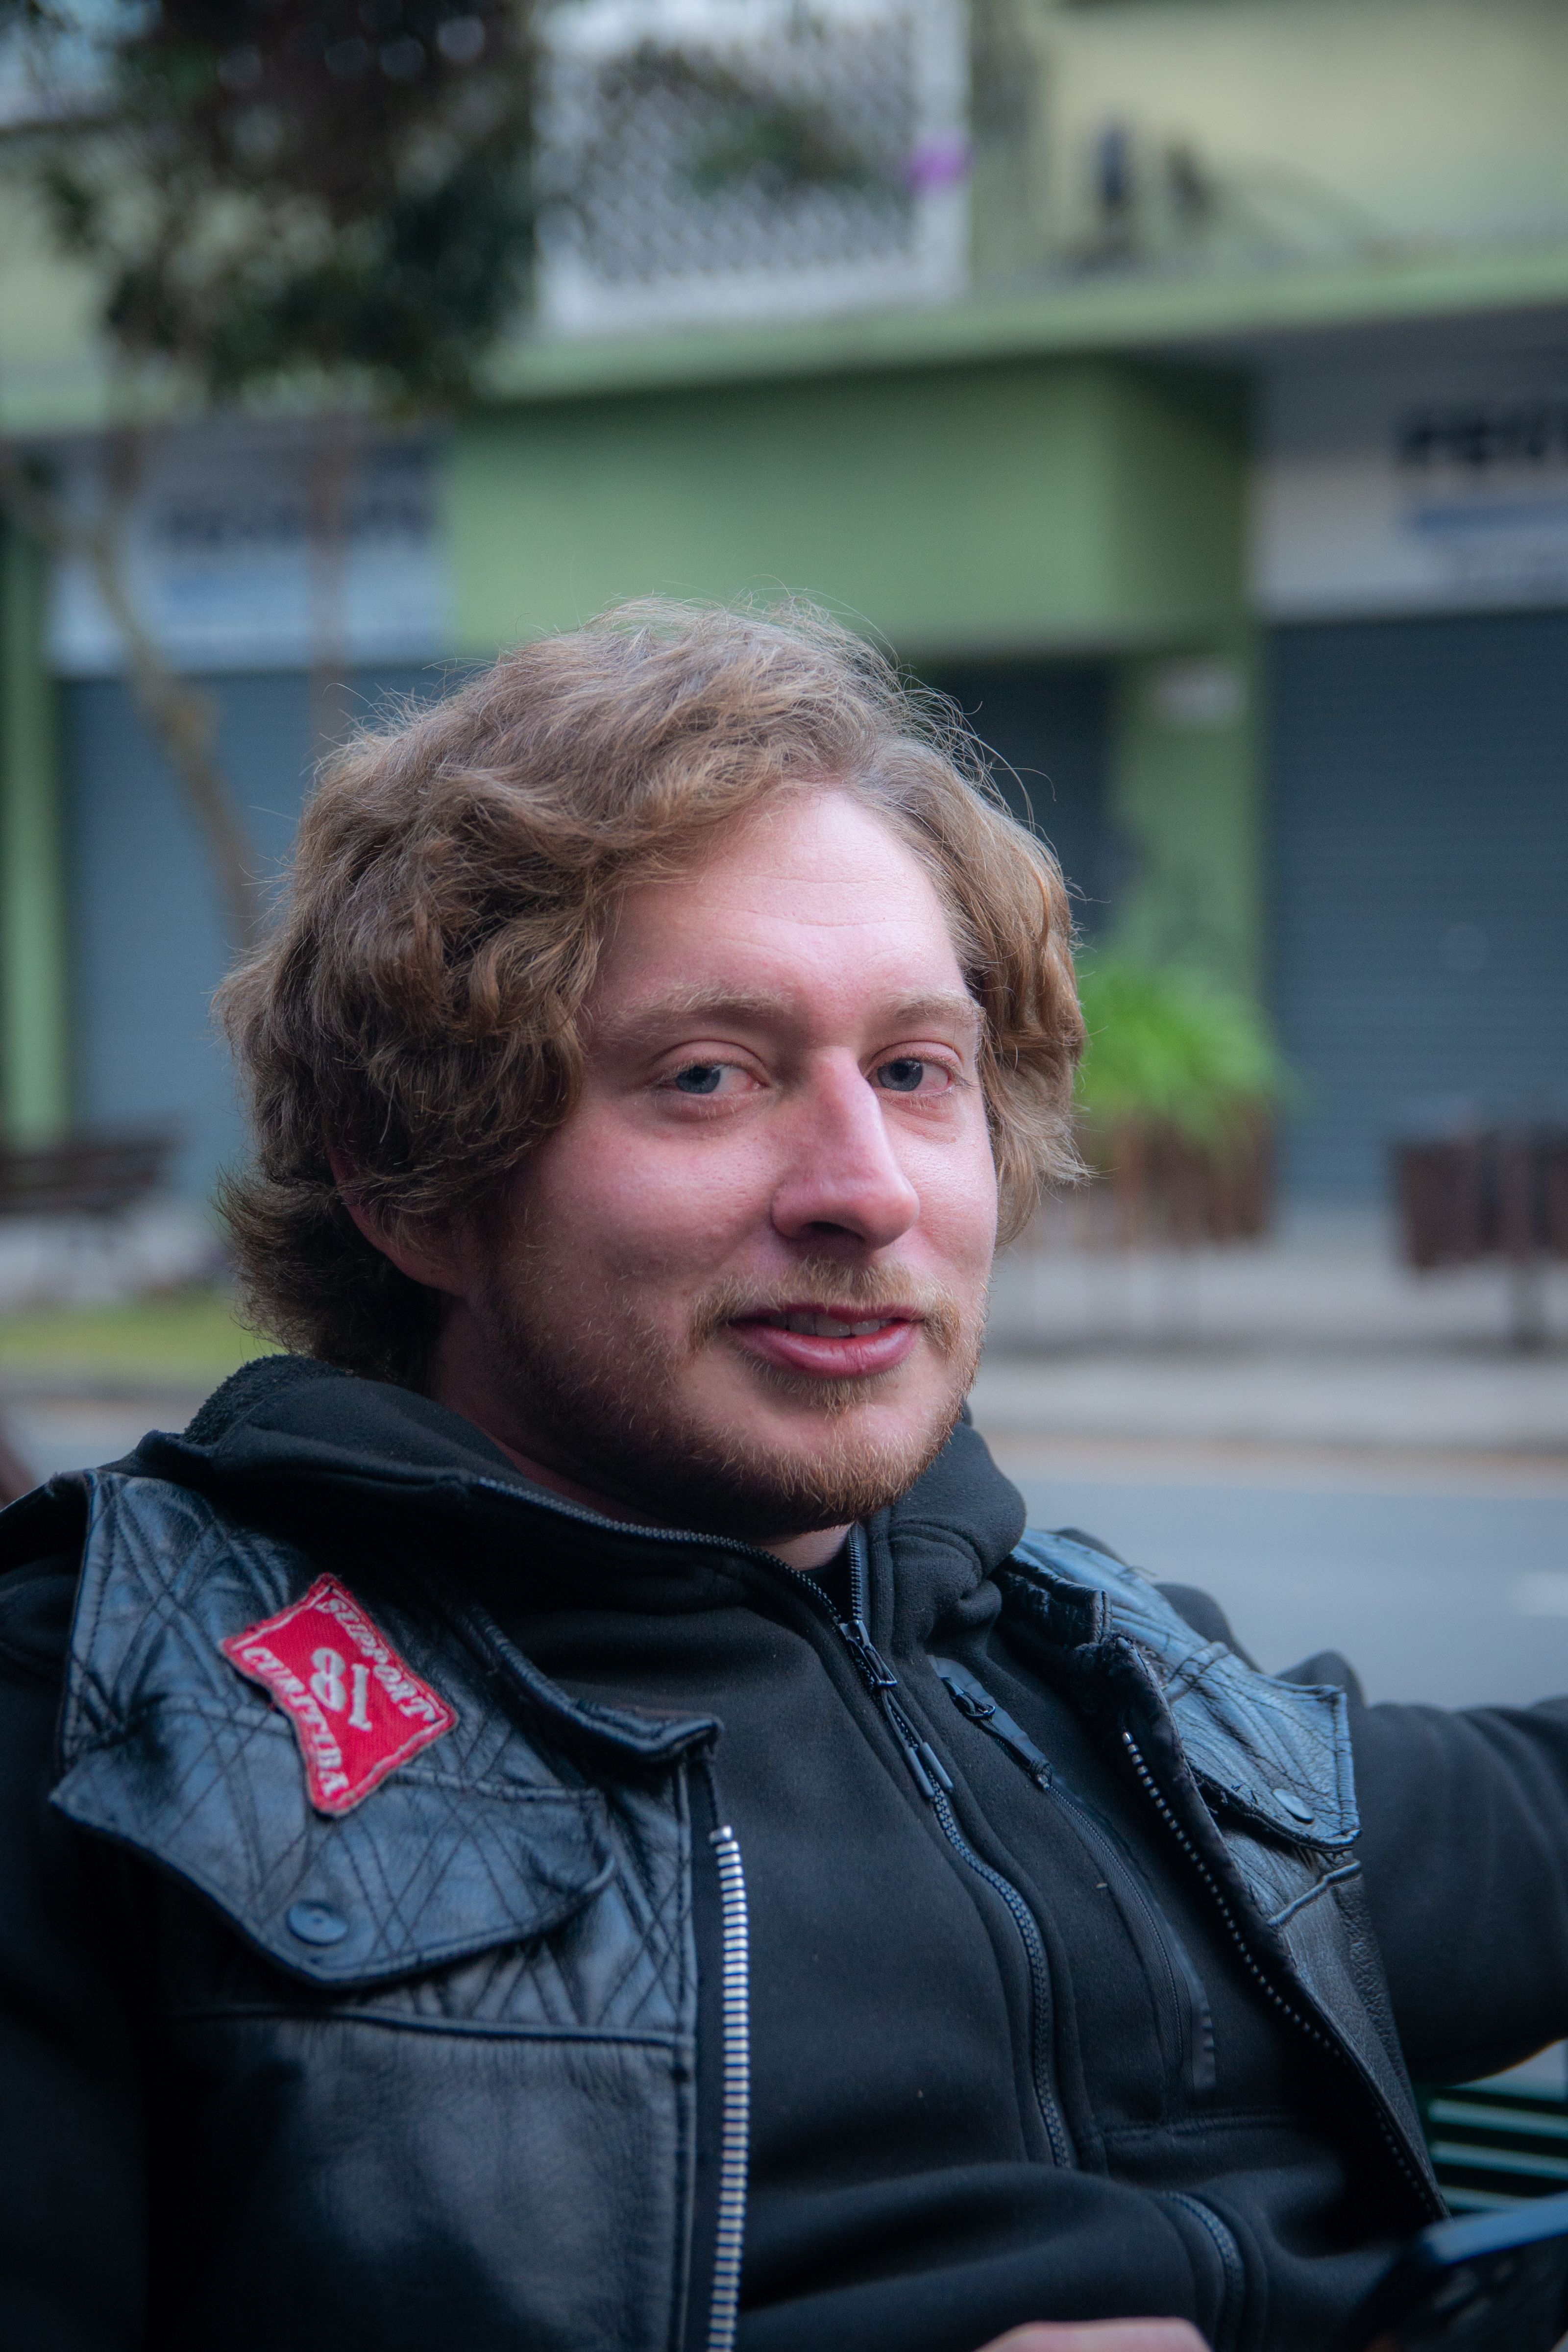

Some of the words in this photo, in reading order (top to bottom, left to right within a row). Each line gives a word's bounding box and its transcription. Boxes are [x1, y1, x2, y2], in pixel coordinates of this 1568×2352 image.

[242, 1646, 348, 1796] CURITIBA
[310, 1647, 372, 1731] 81
[316, 1598, 436, 1722] SUPPORT
